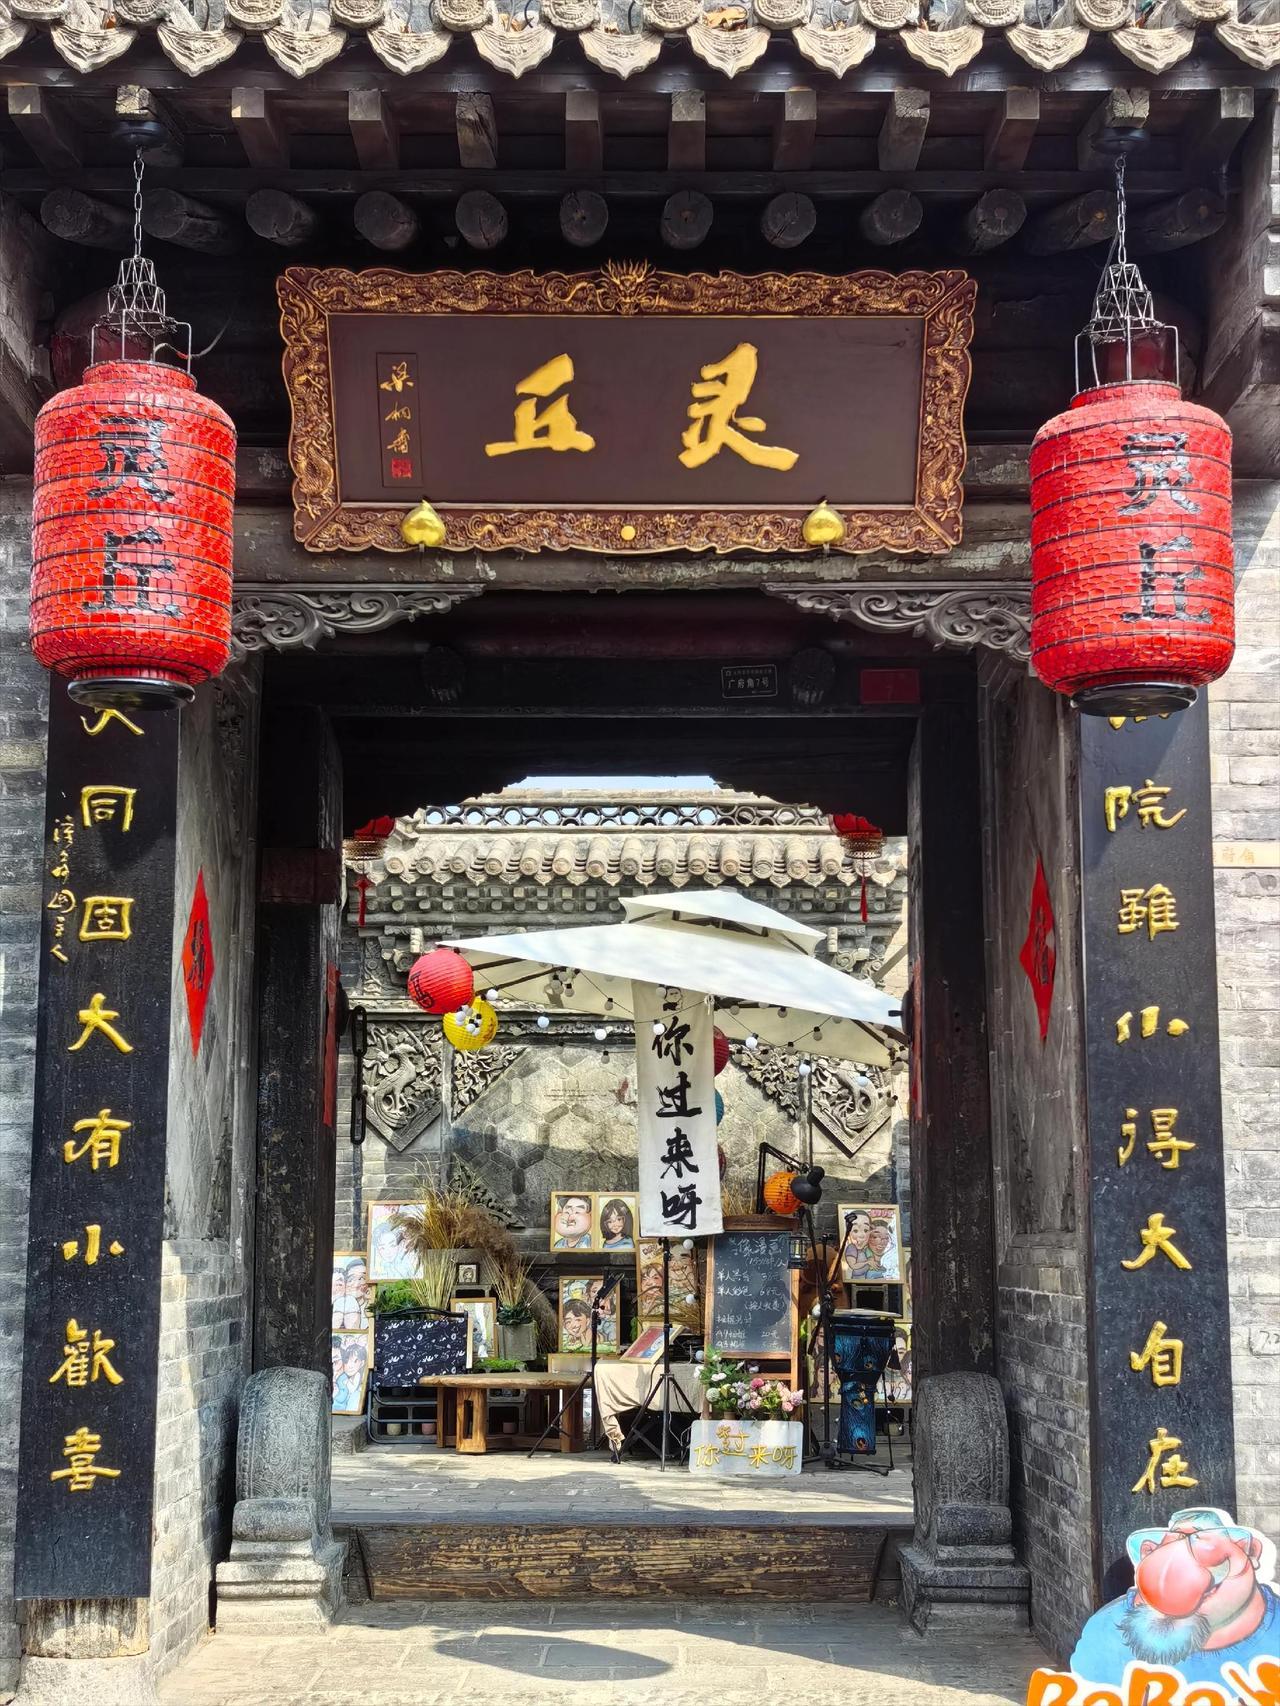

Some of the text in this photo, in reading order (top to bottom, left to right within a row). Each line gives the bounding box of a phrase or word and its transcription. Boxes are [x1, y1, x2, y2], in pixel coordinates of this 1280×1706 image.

[484, 341, 800, 472] 灵丘
[82, 417, 183, 618] 灵丘
[1117, 431, 1214, 625] 灵丘
[651, 1014, 703, 1230] 你过来呀
[1104, 714, 1201, 1495] 院雖小得大自在
